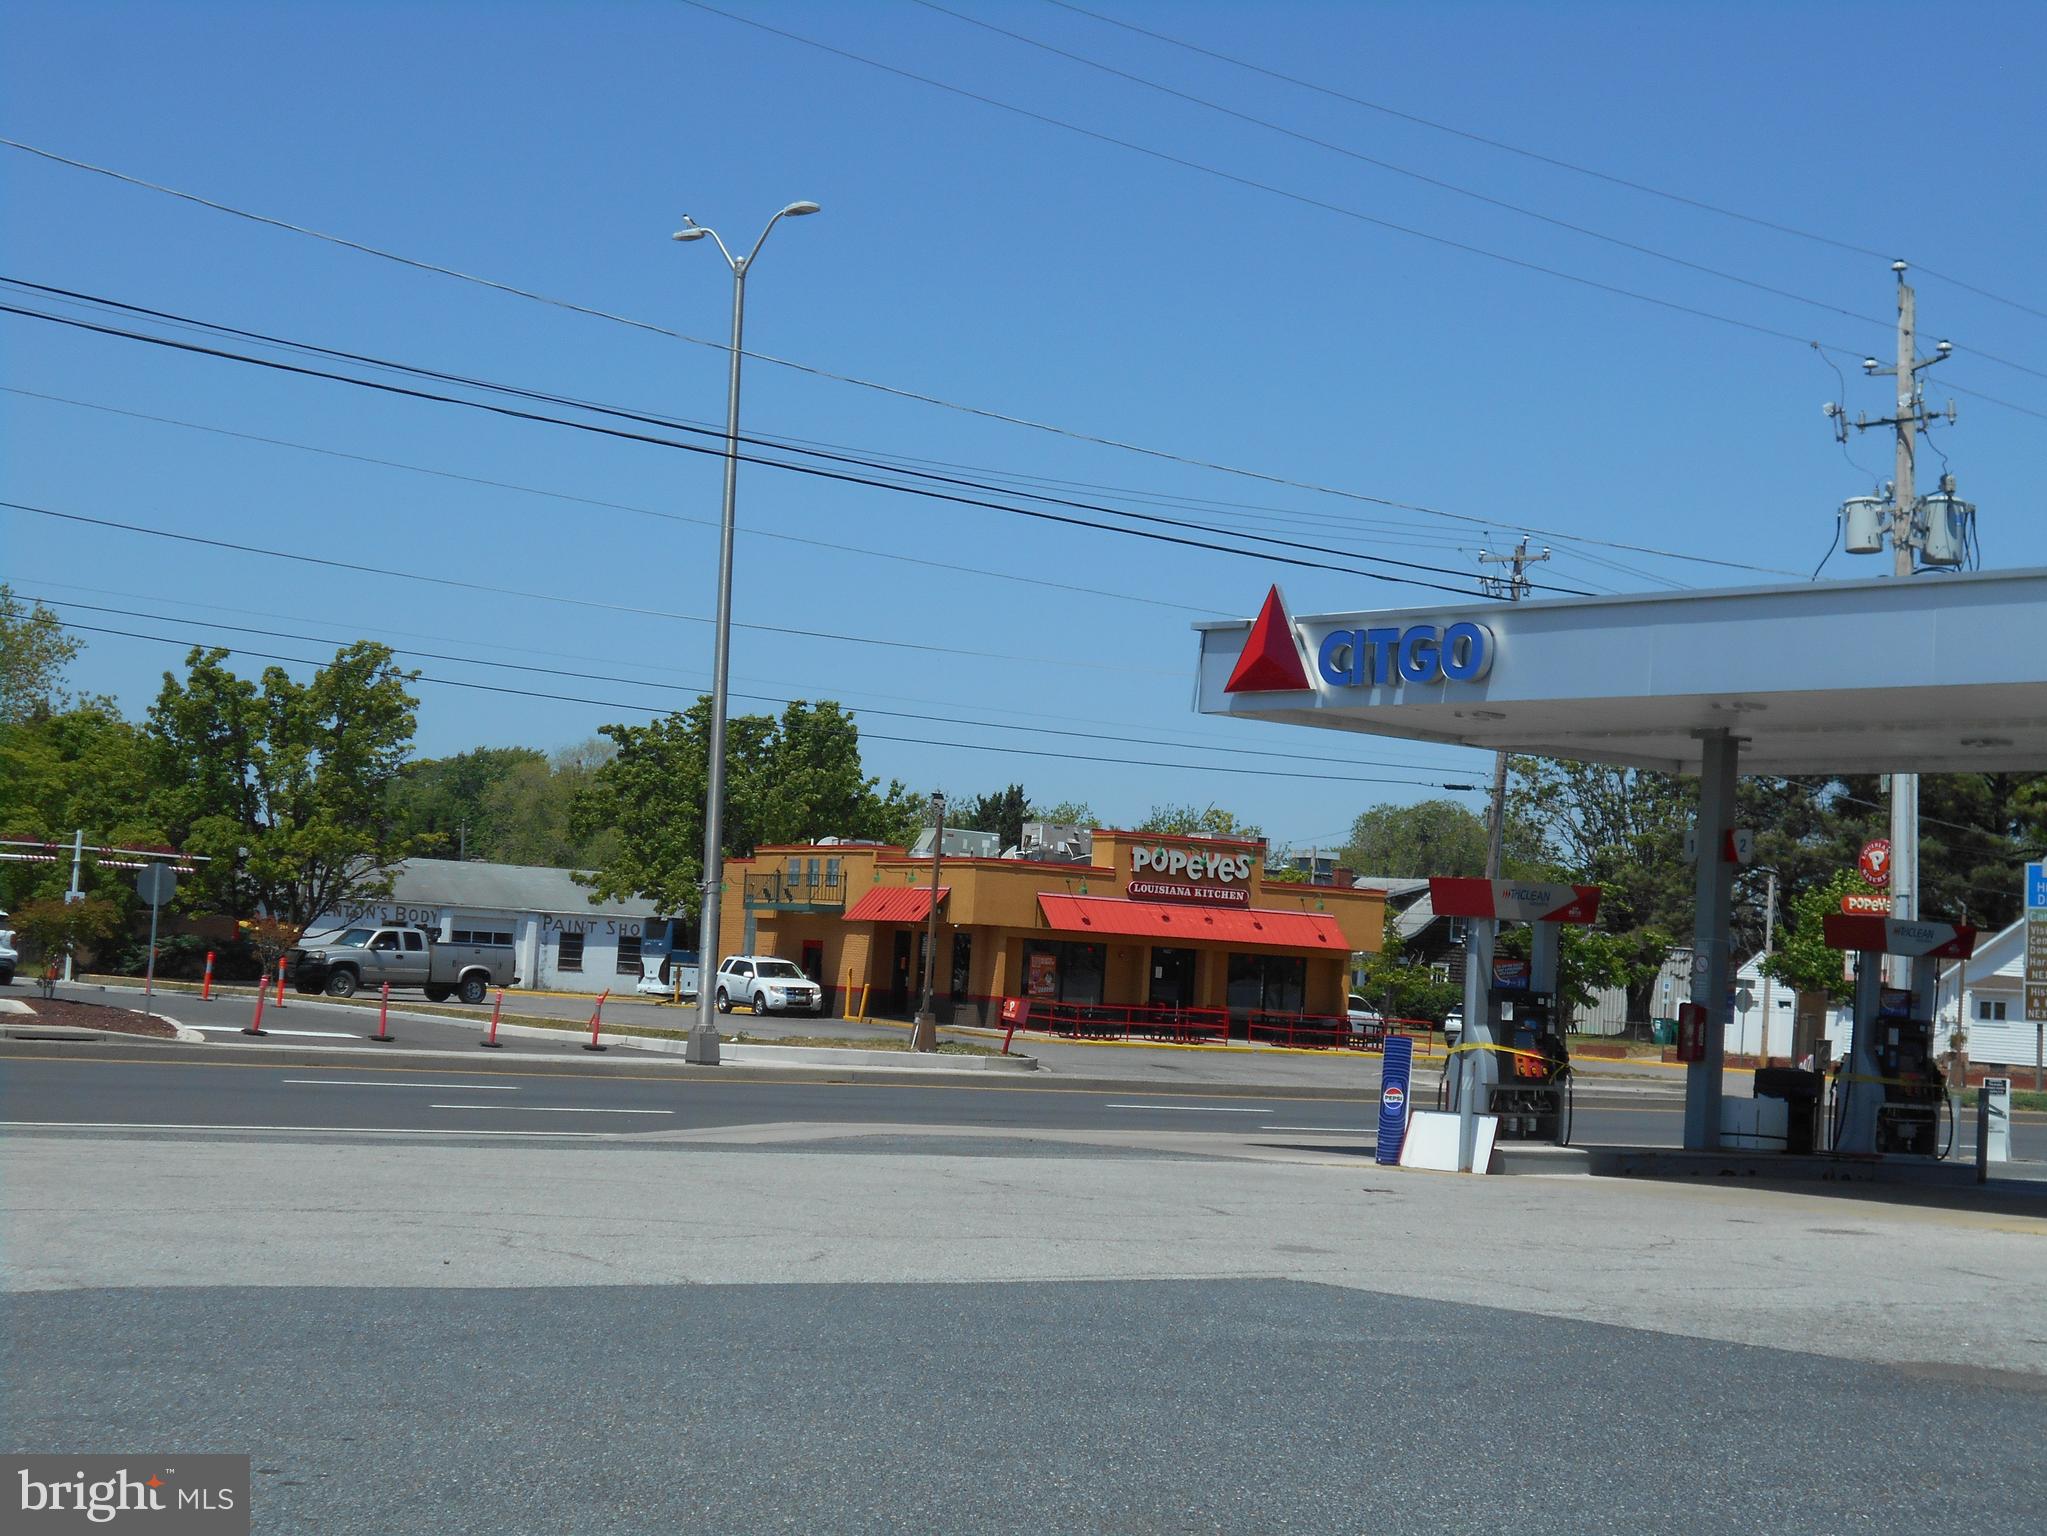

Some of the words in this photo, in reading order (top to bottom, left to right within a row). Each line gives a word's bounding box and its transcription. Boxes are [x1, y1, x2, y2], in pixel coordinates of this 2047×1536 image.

[1318, 622, 1487, 686] CITGO
[1739, 839, 1747, 853] 2
[1868, 850, 1885, 871] P
[1134, 884, 1191, 897] LOUISIANA
[1194, 888, 1245, 901] KITCHEN
[396, 906, 437, 923] BODY
[543, 915, 598, 934] PAINT
[606, 921, 640, 937] SHO
[1384, 1094, 1403, 1102] PEPSI
